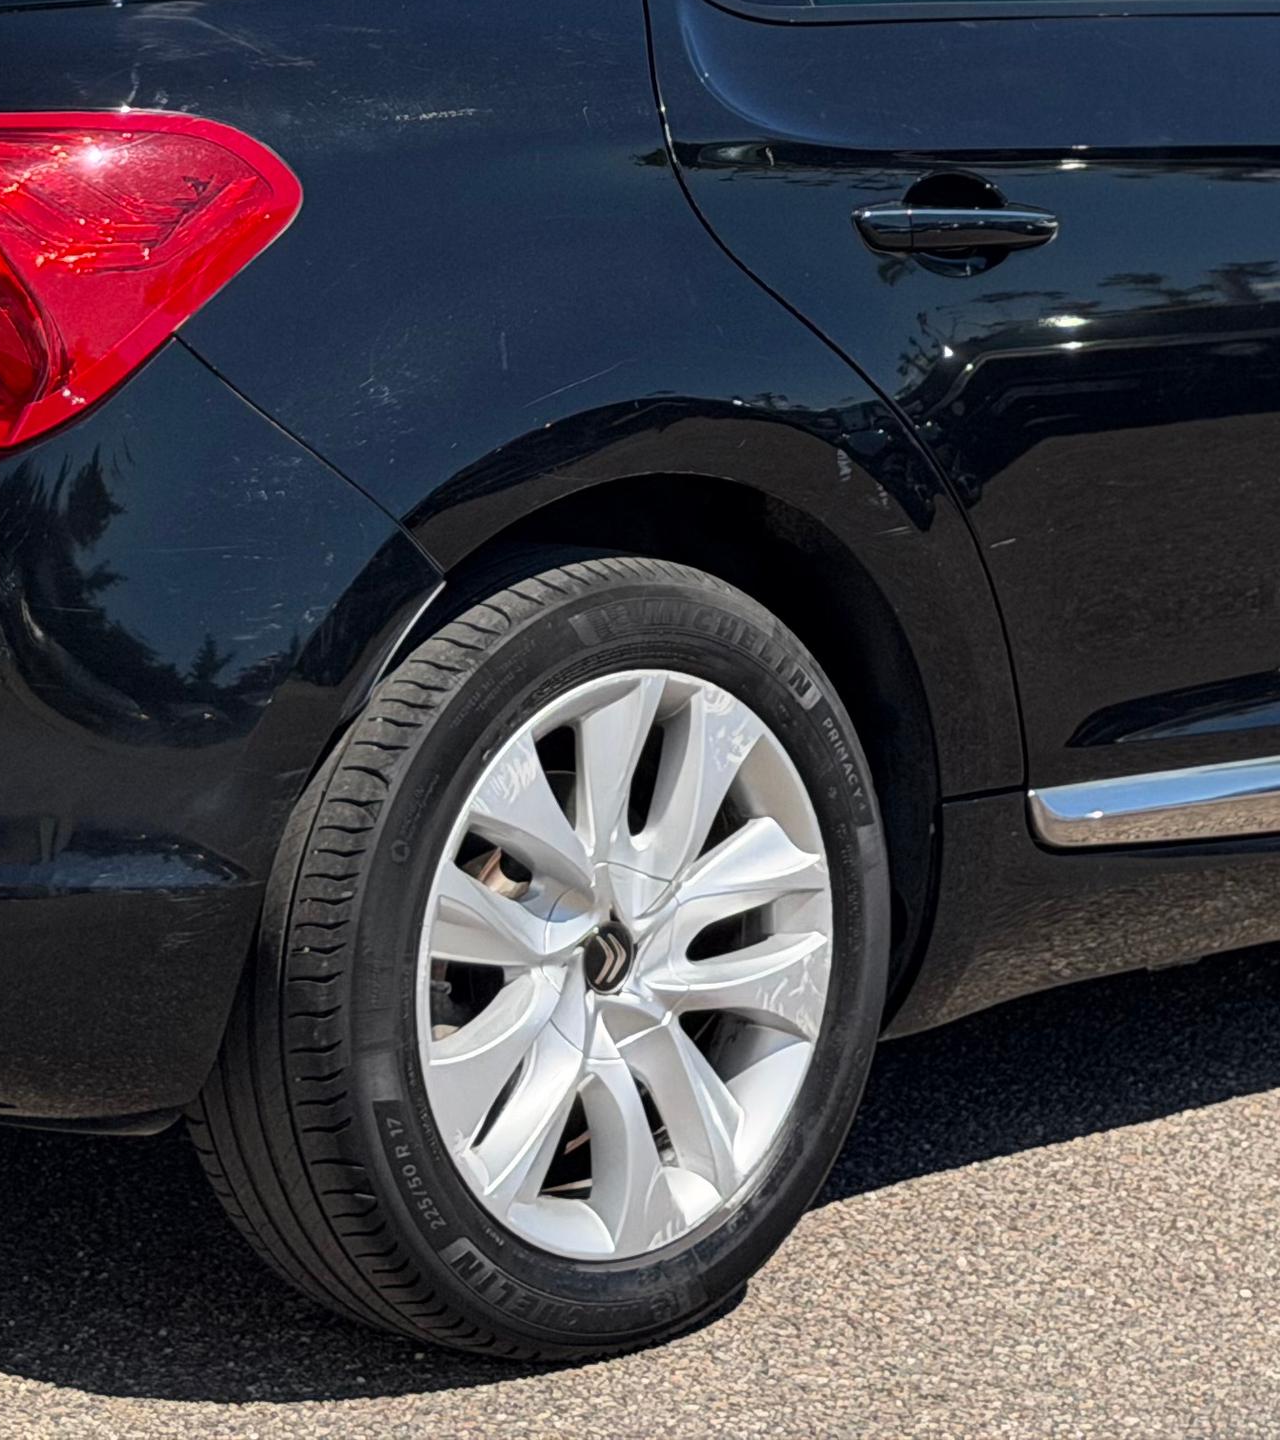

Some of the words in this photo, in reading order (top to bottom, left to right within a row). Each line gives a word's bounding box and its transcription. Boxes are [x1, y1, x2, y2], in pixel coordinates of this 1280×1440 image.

[643, 600, 813, 697] MICHELIN
[822, 716, 863, 797] PRIMACY
[386, 1117, 403, 1137] 17
[395, 1144, 411, 1158] R
[402, 1164, 447, 1230] 225/50
